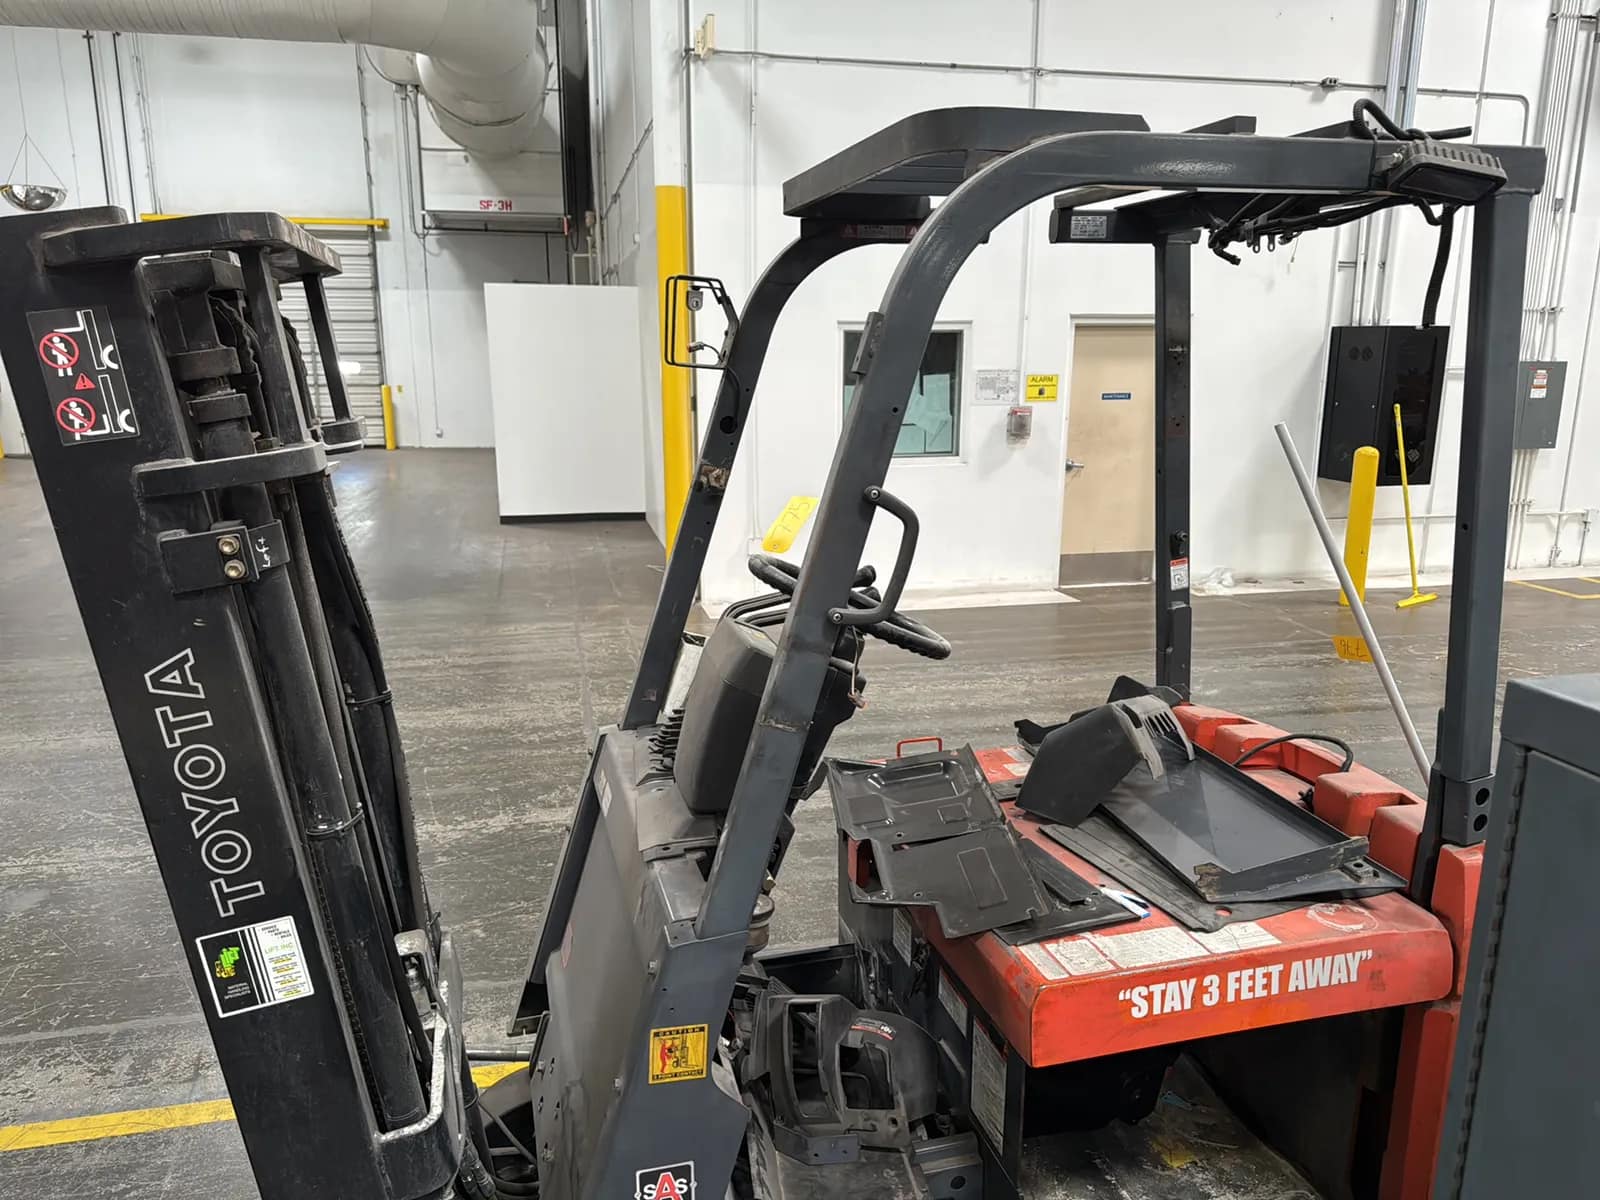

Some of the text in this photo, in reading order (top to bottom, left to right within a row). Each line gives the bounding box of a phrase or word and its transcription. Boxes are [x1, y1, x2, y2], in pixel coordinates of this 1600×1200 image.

[144, 647, 266, 918] TOYOTA
[1202, 974, 1220, 1007] 3
[1226, 963, 1284, 1003] FEET
